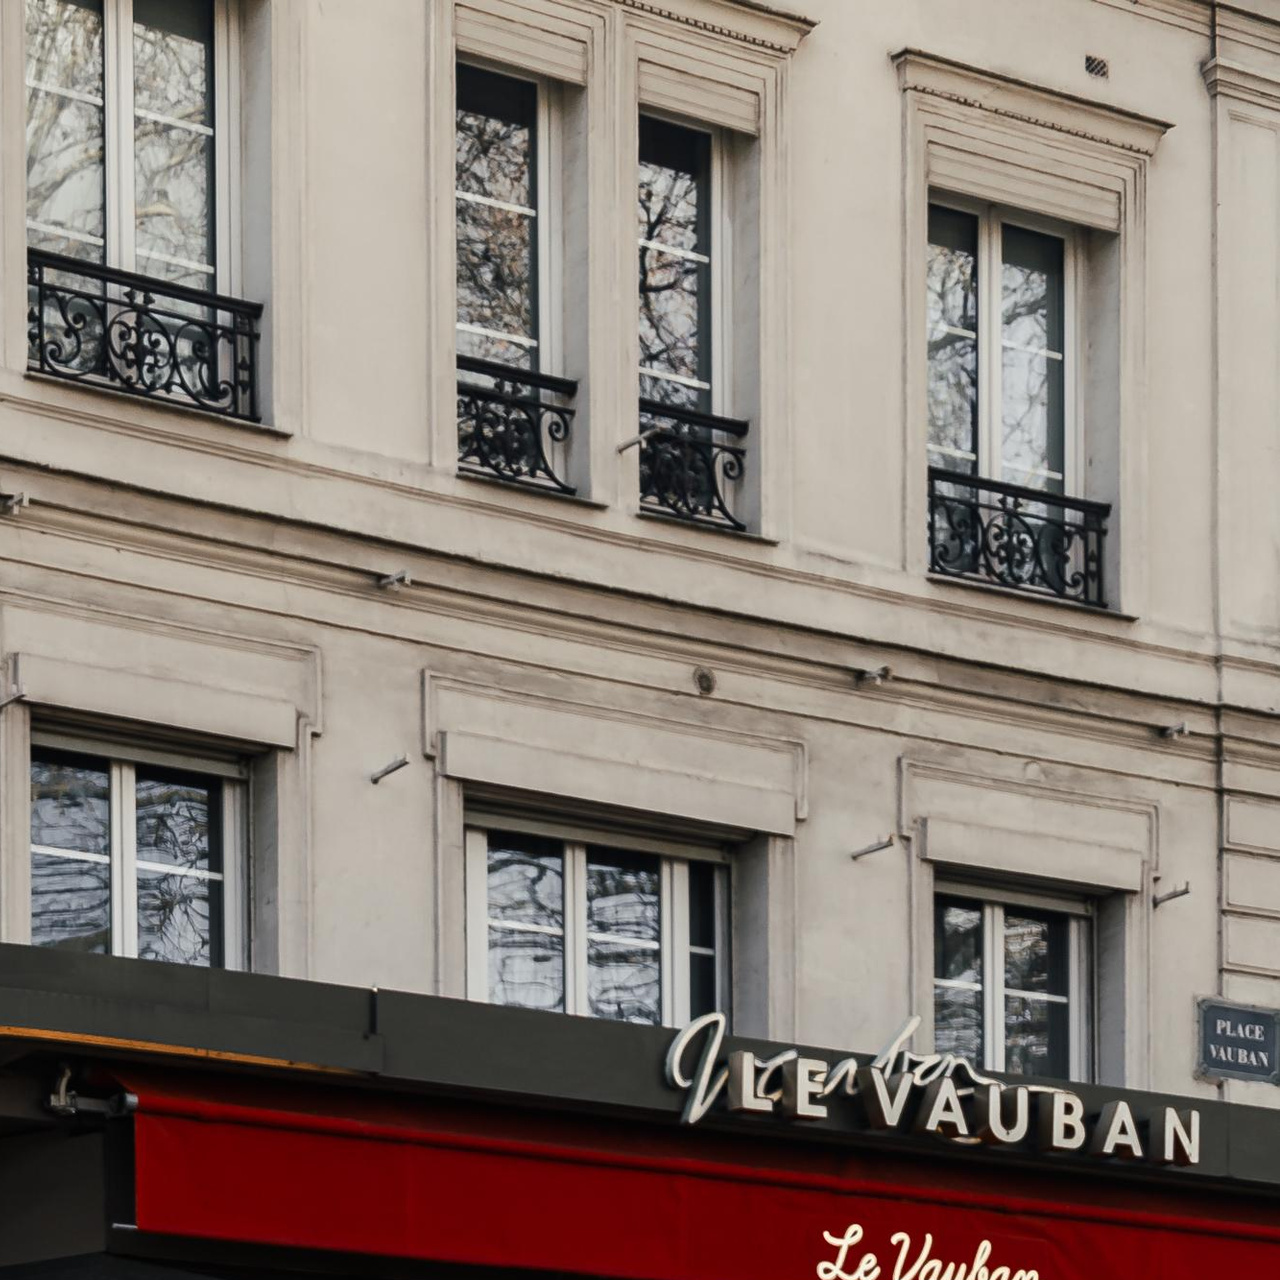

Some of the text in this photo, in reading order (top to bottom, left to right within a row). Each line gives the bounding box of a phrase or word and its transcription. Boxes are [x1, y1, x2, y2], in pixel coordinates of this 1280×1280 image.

[1216, 1019, 1265, 1041] PLACE
[1209, 1043, 1269, 1067] VAUBAN
[734, 1051, 1201, 1165] LE VAUBAN
